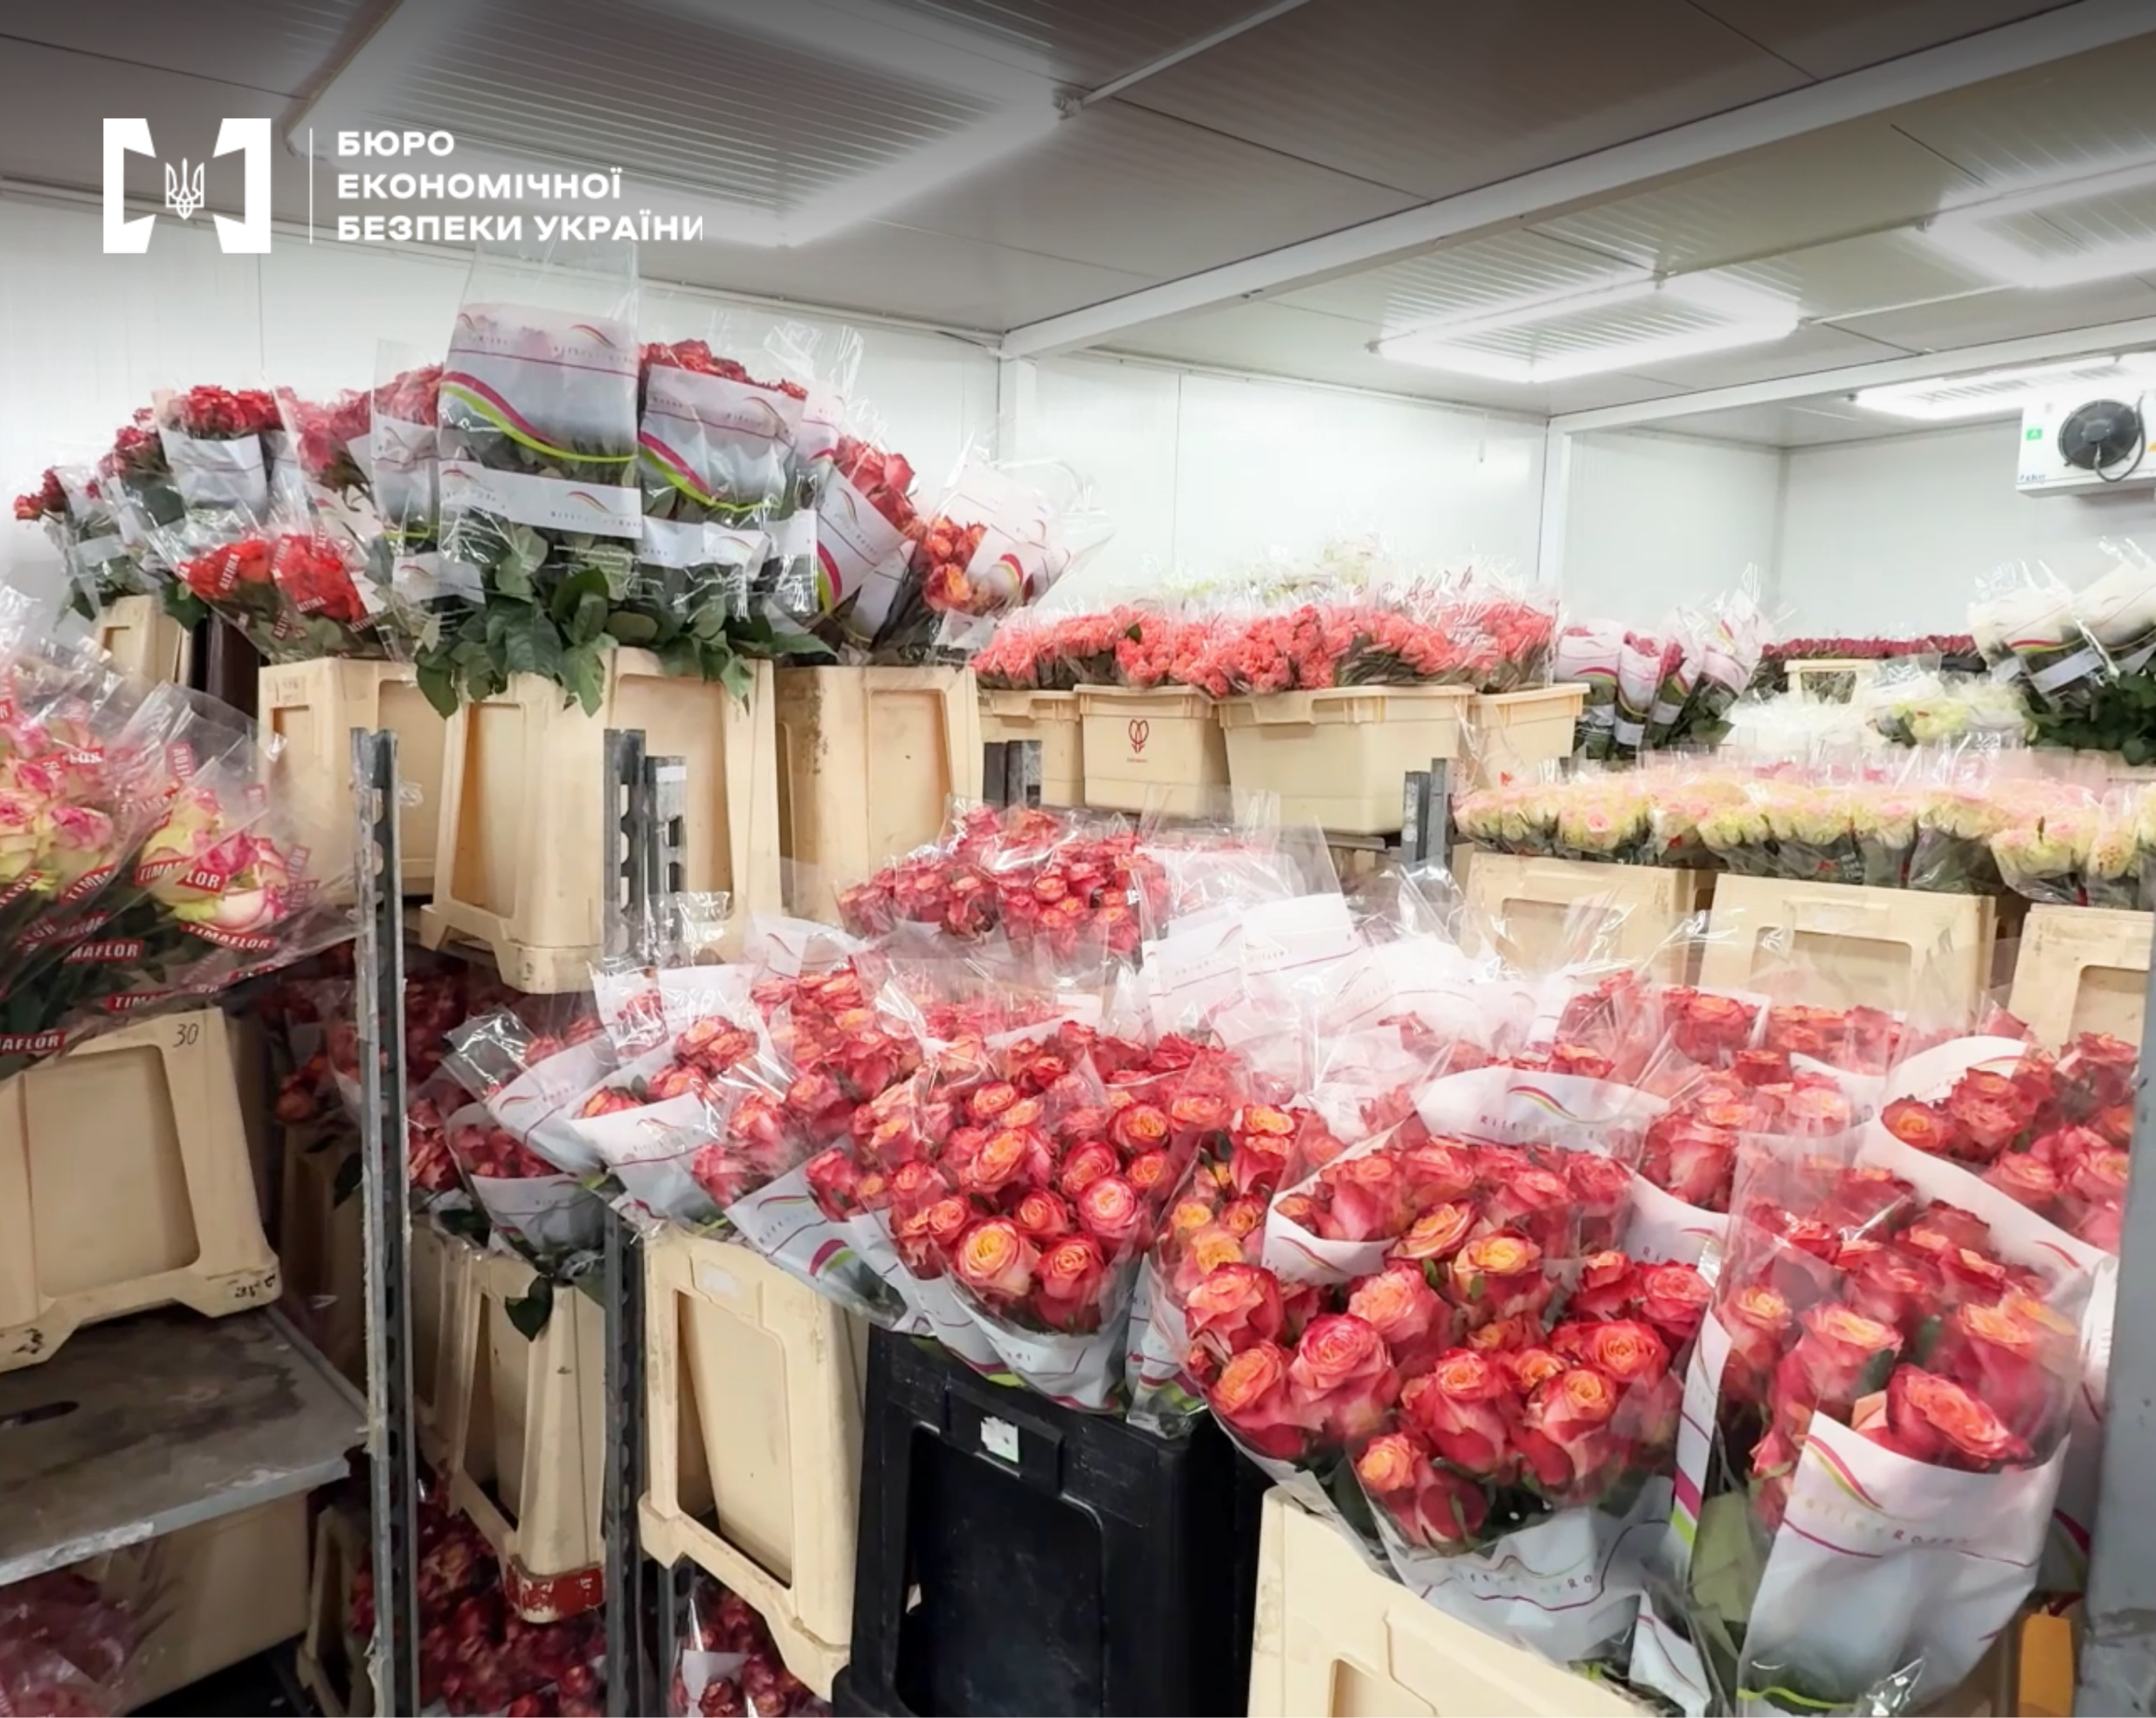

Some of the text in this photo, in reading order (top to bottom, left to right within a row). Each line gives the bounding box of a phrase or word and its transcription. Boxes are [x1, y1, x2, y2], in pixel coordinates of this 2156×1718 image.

[186, 925, 271, 949] TIMAFLOR
[0, 1035, 59, 1050] AFLOR
[173, 1024, 199, 1048] 30
